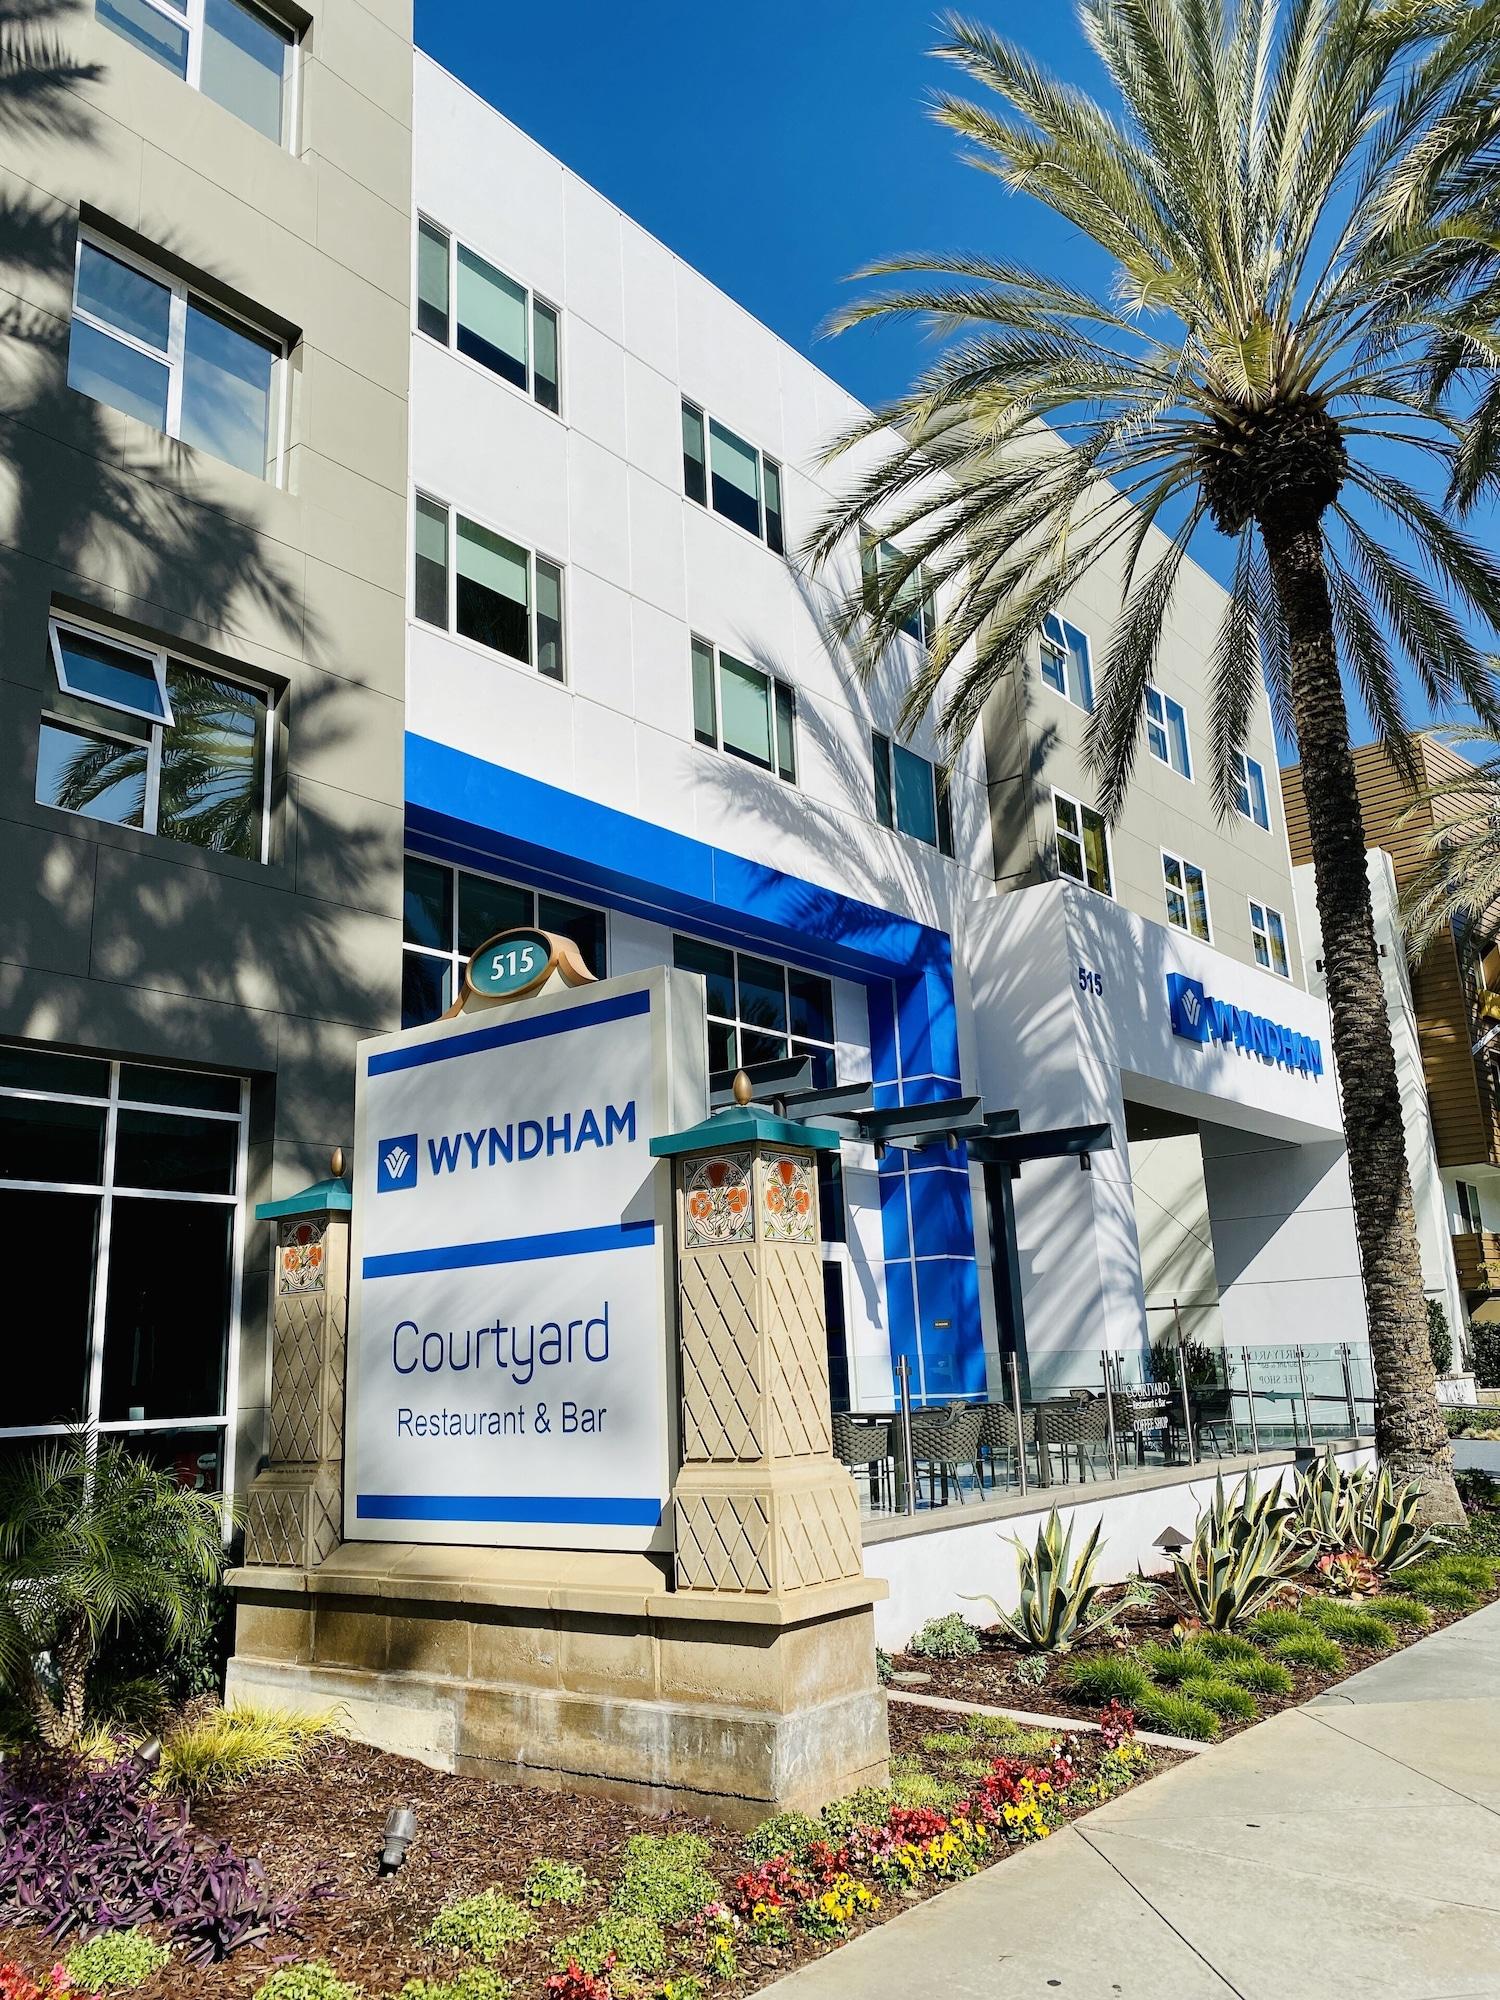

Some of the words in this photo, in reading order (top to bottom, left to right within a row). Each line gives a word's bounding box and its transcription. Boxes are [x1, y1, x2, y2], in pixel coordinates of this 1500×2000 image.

[490, 947, 534, 981] 515
[1079, 966, 1103, 997] 515
[1205, 997, 1324, 1075] WYNDHAM
[428, 1100, 636, 1176] WYNDHAM
[393, 1301, 609, 1385] Courtyard
[1126, 1382, 1170, 1398] COURTYARD
[398, 1405, 525, 1437] Restaurant
[534, 1402, 551, 1434] &
[562, 1402, 607, 1433] Bar
[1133, 1417, 1154, 1431] COFFEE
[1154, 1416, 1169, 1430] SHOP
